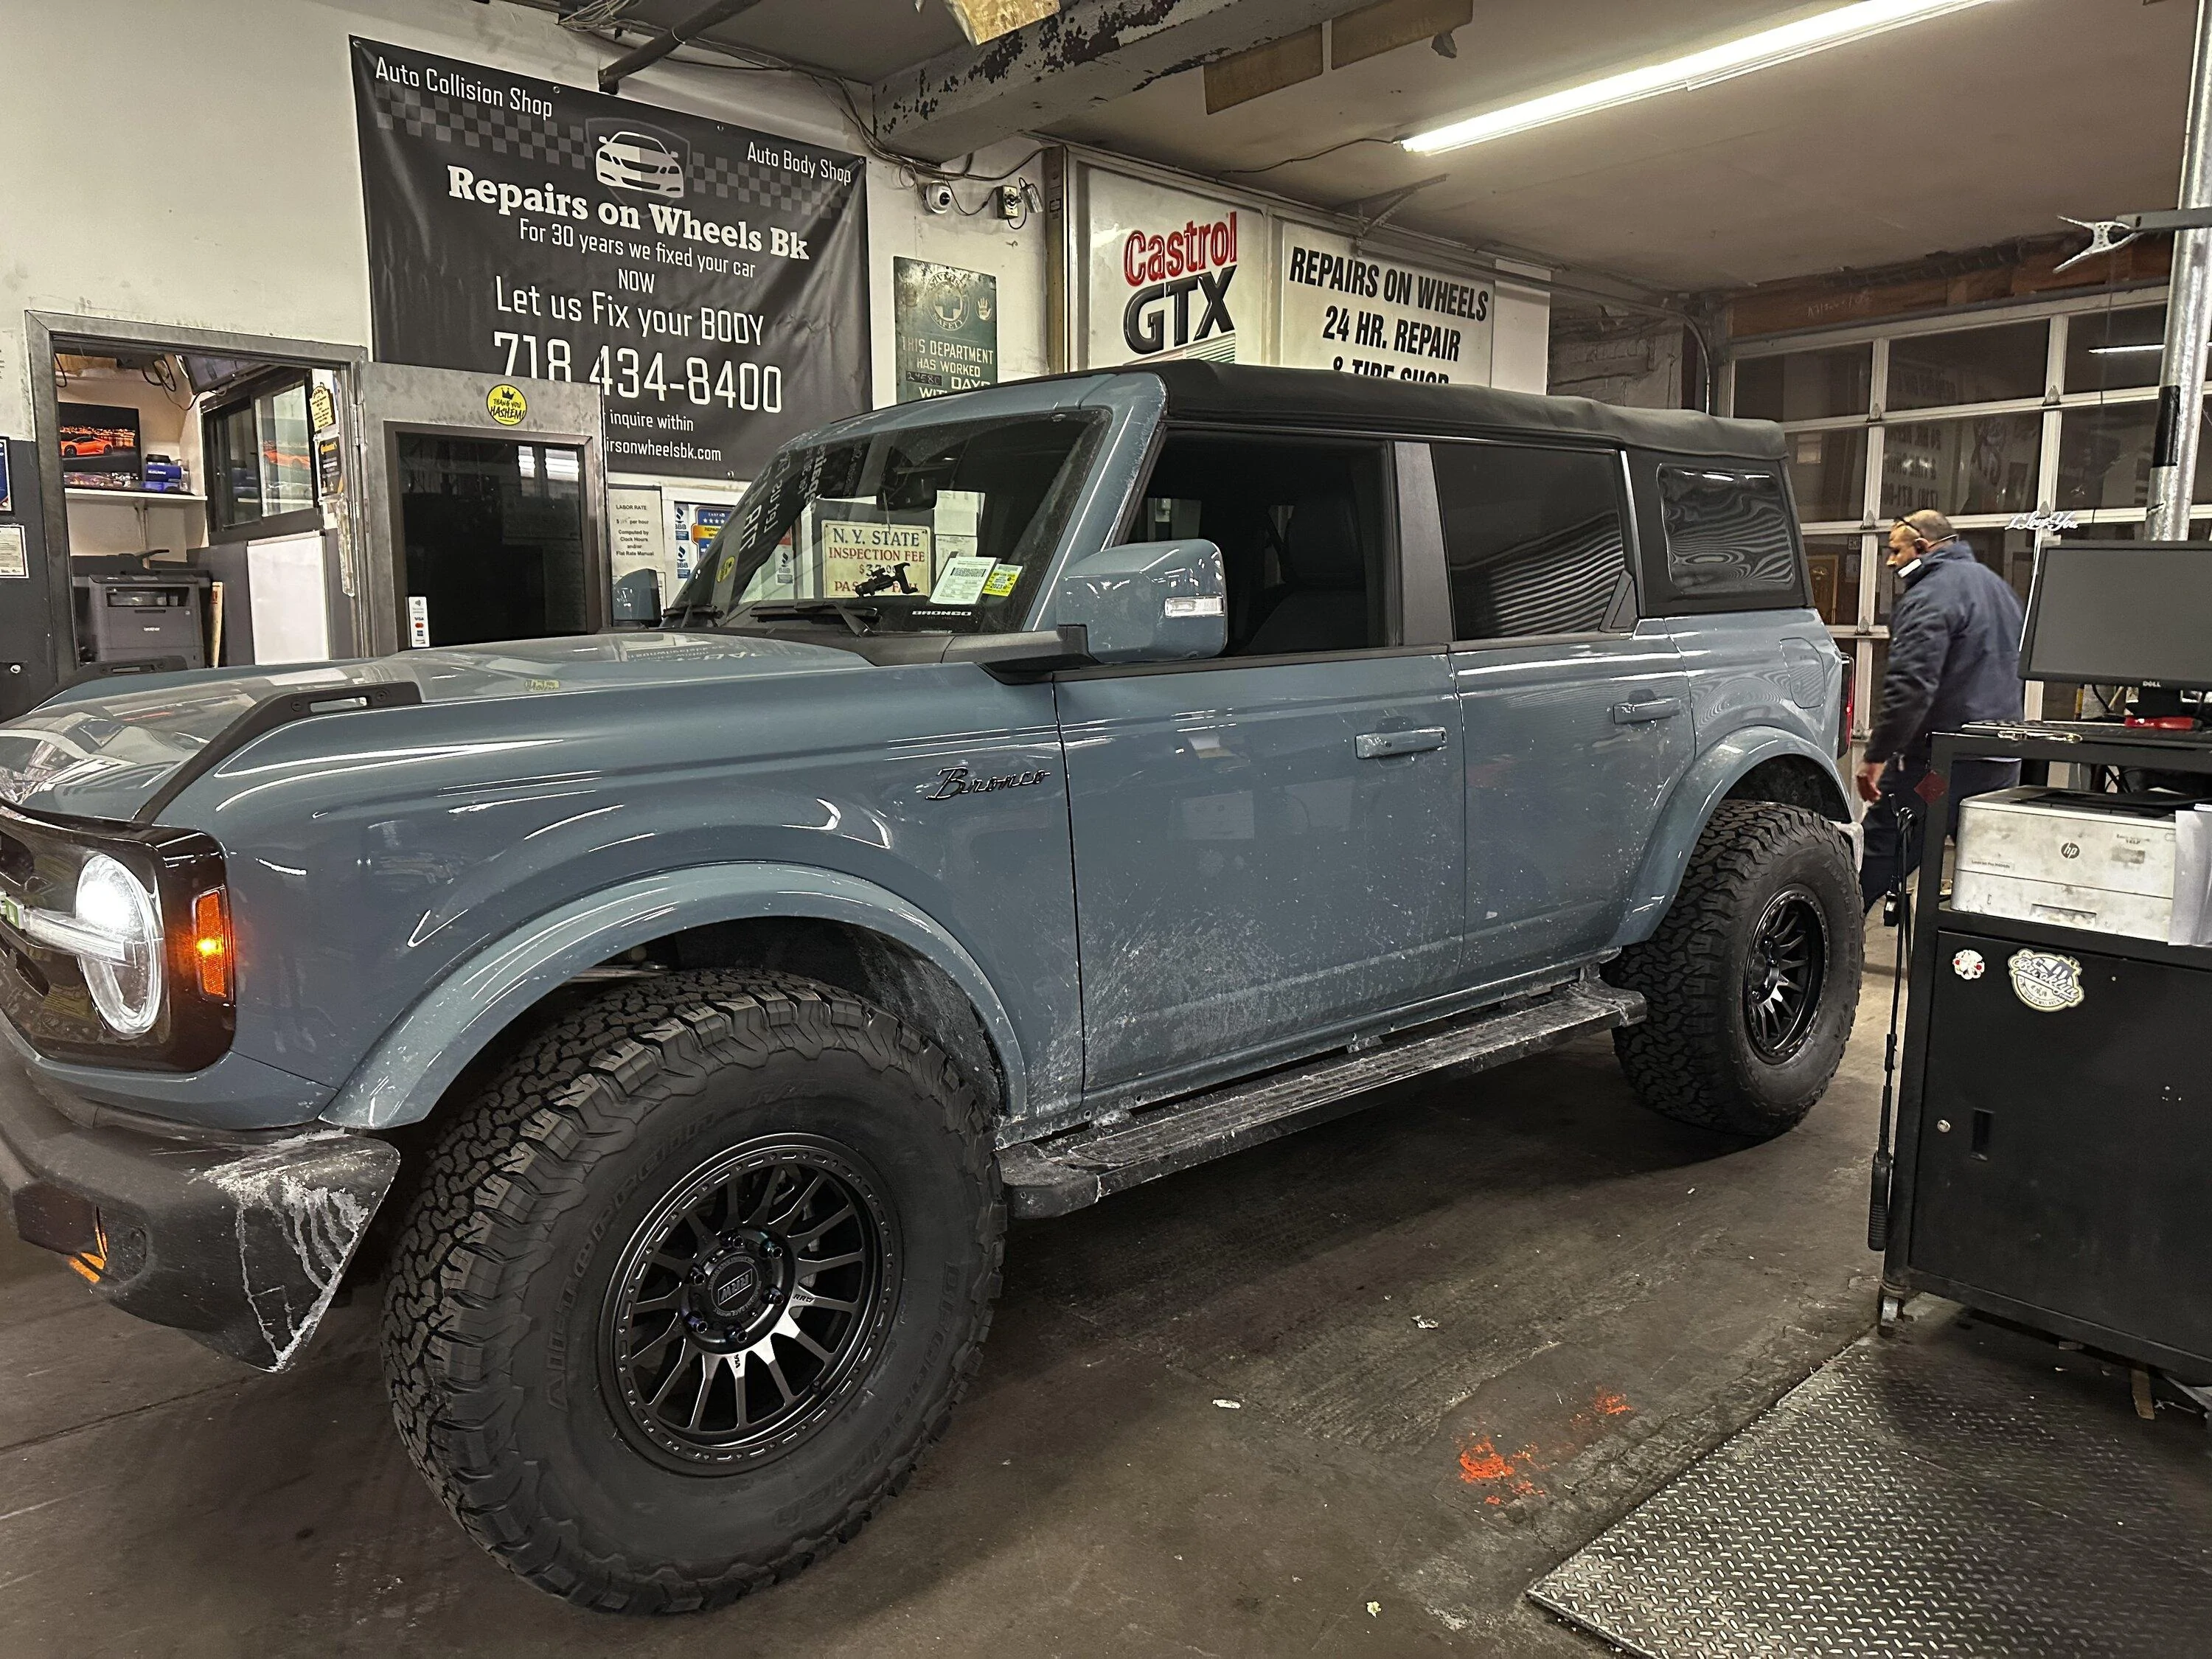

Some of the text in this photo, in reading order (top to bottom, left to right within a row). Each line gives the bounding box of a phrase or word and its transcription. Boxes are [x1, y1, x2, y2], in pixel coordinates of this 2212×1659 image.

[375, 56, 552, 120] Auto Collision Shop
[747, 142, 851, 186] Auto Body Shop
[447, 165, 810, 260] Repairs on Wheels Bk
[520, 218, 756, 279] For 30 years we fixed your car
[1124, 211, 1237, 287] Castrol
[618, 268, 655, 293] NOW
[1290, 246, 1489, 321] REPAIRS ON WHEELS
[495, 275, 764, 346] Let us Fix your BODY
[933, 313, 963, 329] SAFETY
[1124, 265, 1237, 355] GTX
[1322, 305, 1461, 362] 24 HR. REPAIR
[902, 336, 993, 365] THIS DEPARTMENT
[493, 331, 782, 414] 718 434-8400
[917, 357, 981, 377] HAS WORKED
[490, 406, 525, 420] HASHEM!
[610, 412, 695, 432] inquire within
[606, 437, 722, 462] irsonwheelsbk.com
[2025, 510, 2051, 529] Love
[2049, 510, 2079, 531] You
[833, 528, 919, 546] N. Y. STATE
[829, 547, 925, 563] INSPECTION FEE
[925, 766, 1051, 800] Bronco
[2062, 842, 2079, 859] hp
